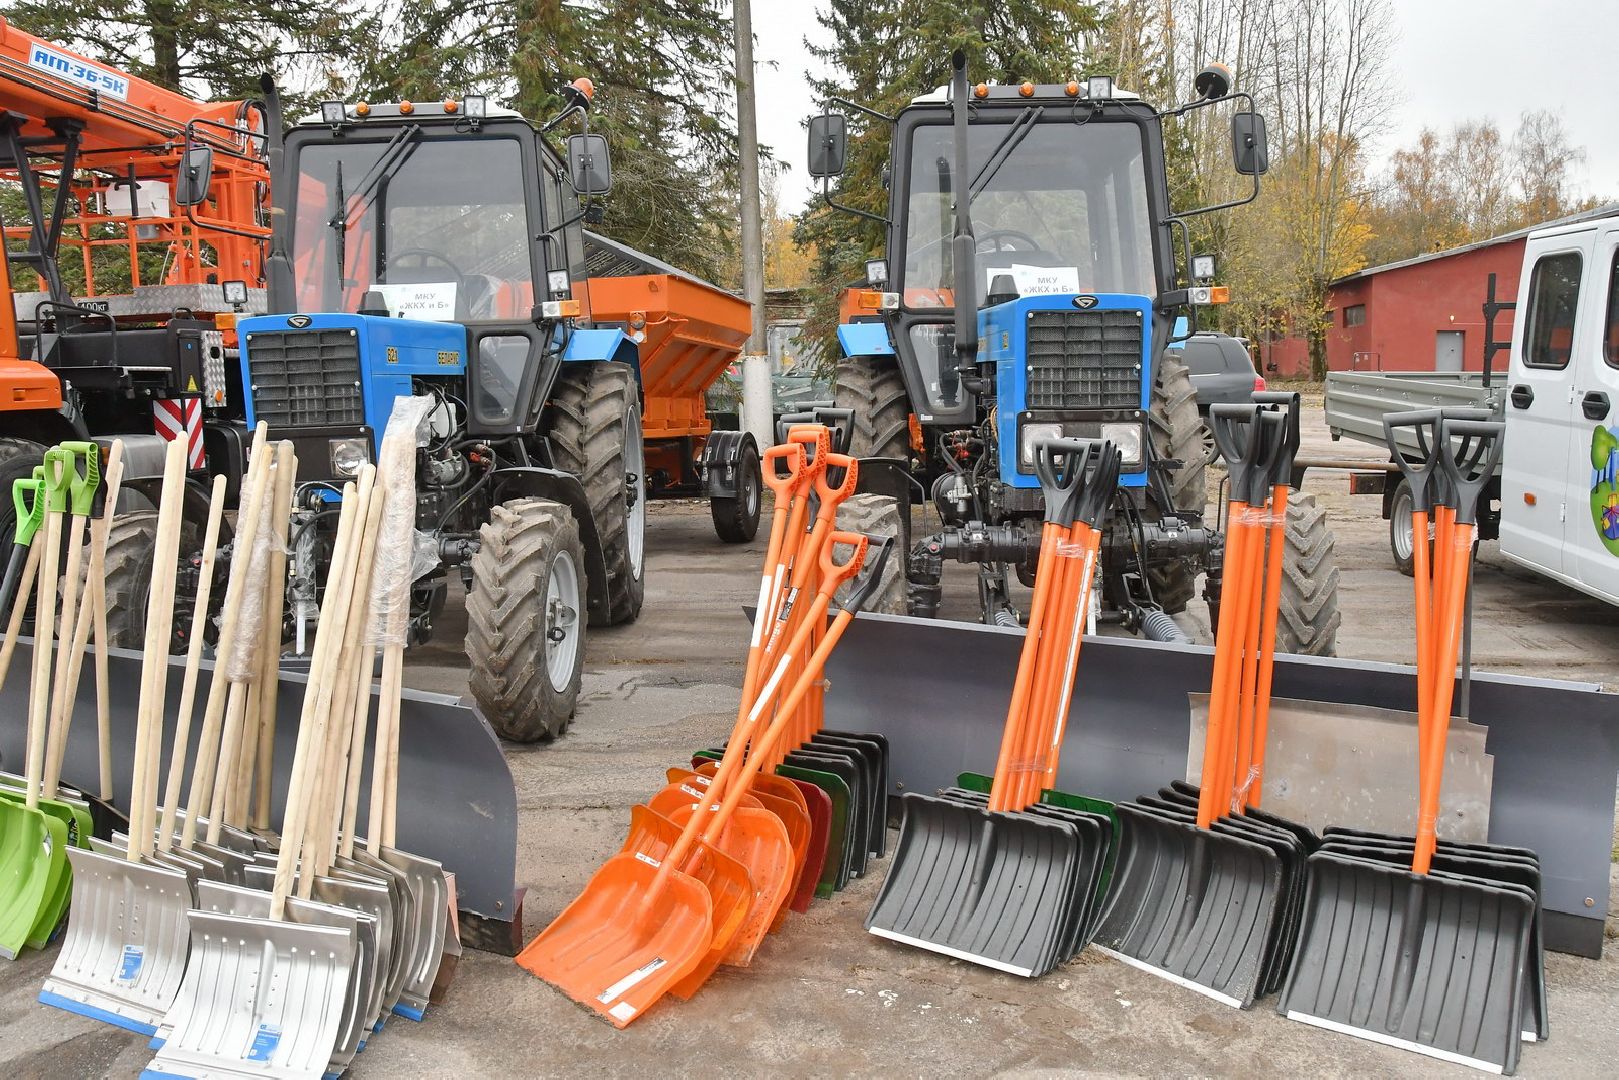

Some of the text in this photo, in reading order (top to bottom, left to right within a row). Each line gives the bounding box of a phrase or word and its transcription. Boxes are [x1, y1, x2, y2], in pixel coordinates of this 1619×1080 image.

[1037, 276, 1058, 284] МКУ
[1023, 285, 1050, 293] «ЖКХ
[1061, 285, 1074, 293] Б»
[415, 292, 436, 300] МКУ
[400, 301, 425, 310] «ЖКХ
[437, 301, 449, 309] Б»
